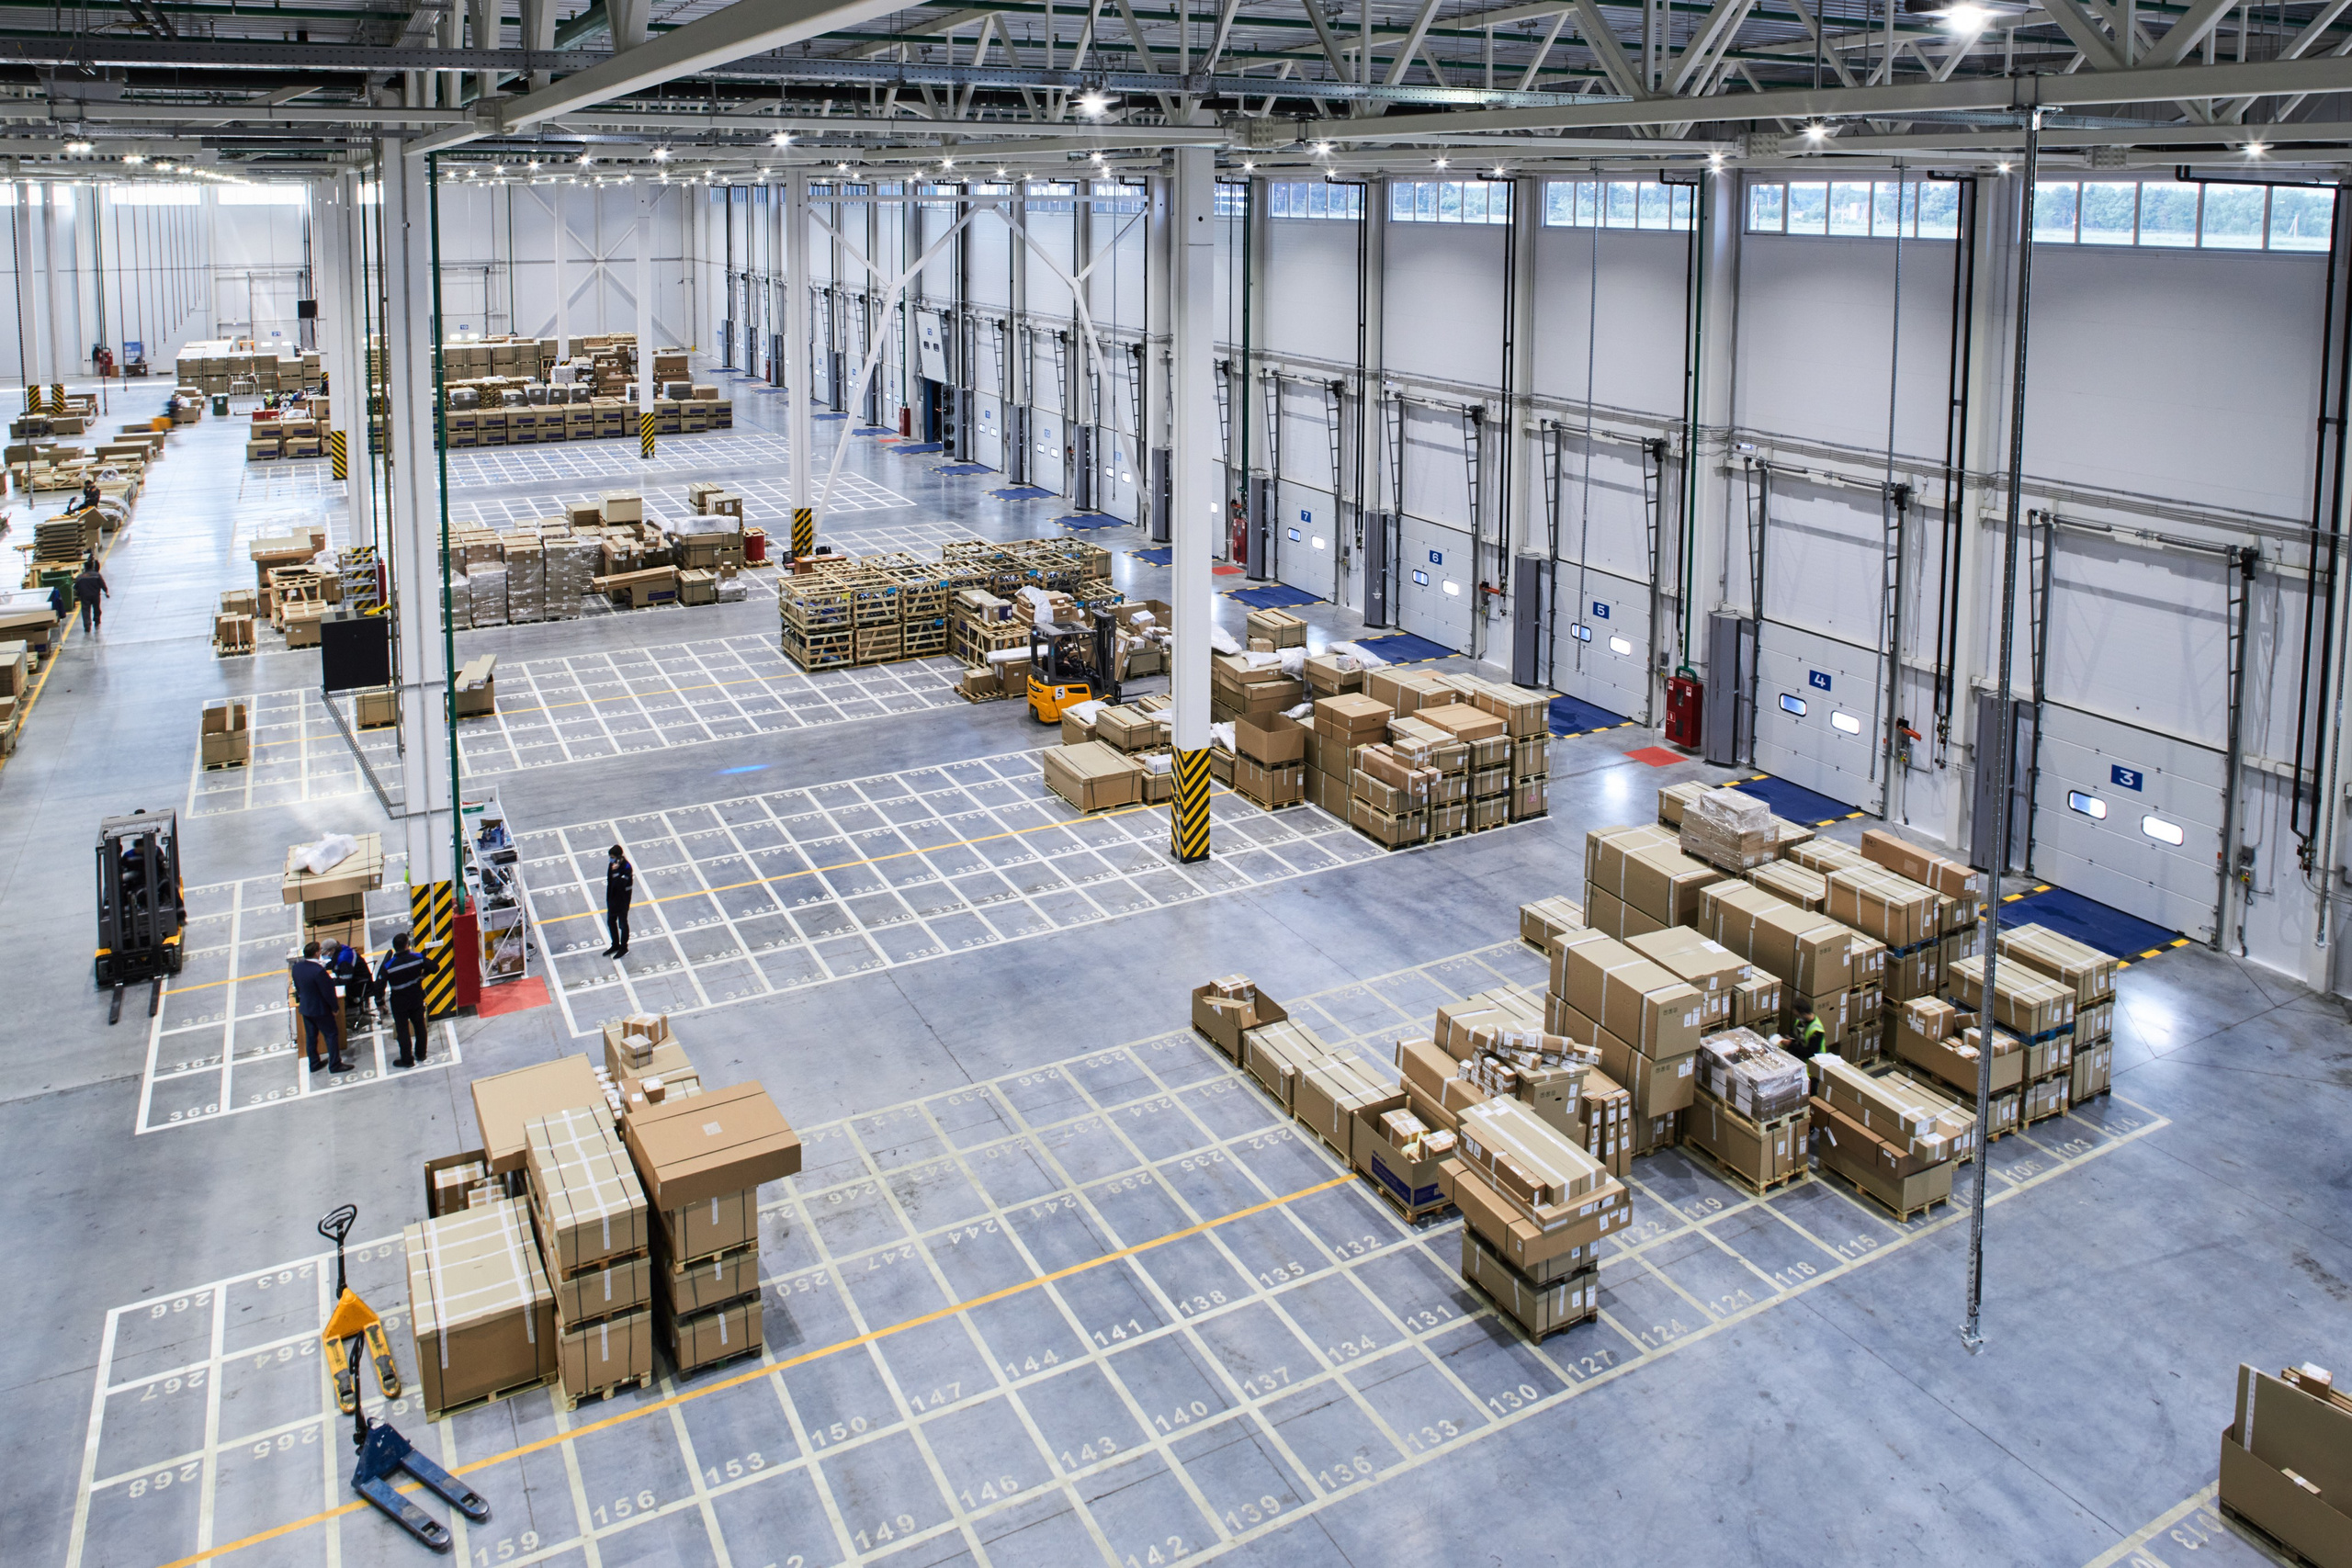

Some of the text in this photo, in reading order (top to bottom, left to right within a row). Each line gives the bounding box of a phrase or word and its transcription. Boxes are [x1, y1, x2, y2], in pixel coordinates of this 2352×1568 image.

[1432, 553, 1439, 563] 6
[1597, 605, 1605, 616] 5
[1057, 688, 1062, 697] 5
[1814, 673, 1826, 687] 4
[2119, 770, 2134, 786] 3
[662, 998, 701, 1013] 351
[181, 1012, 227, 1027] 368
[1151, 1033, 1190, 1051] 230
[175, 1055, 222, 1072] 367
[1086, 1051, 1125, 1068] 233
[330, 1069, 376, 1087] 360
[1018, 1068, 1059, 1087] 236
[1199, 1079, 1238, 1098] 231
[250, 1086, 299, 1104] 363
[1129, 1097, 1172, 1117] 234
[170, 1103, 220, 1122] 366
[1061, 1117, 1102, 1138] 237
[1250, 1130, 1292, 1150] 232
[1181, 1151, 1224, 1172] 235
[2056, 1138, 2092, 1159] 103
[1107, 1173, 1152, 1194] 238
[2005, 1160, 2043, 1181] 106
[828, 1183, 877, 1204] 246
[1029, 1196, 1076, 1218] 241
[1684, 1198, 1723, 1220] 119
[946, 1221, 998, 1244] 244
[1620, 1222, 1666, 1247] 122
[866, 1246, 914, 1270] 247
[1336, 1235, 1382, 1260] 132
[1838, 1235, 1878, 1258] 115
[258, 1263, 313, 1289] 263
[776, 1269, 829, 1298] 250
[1260, 1262, 1305, 1289] 135
[1775, 1260, 1816, 1286] 118
[152, 1291, 210, 1319] 266
[1179, 1290, 1227, 1316] 138
[1710, 1289, 1754, 1319] 121
[1408, 1304, 1453, 1331] 131
[1094, 1318, 1143, 1347] 141
[1641, 1318, 1688, 1348] 124
[254, 1338, 315, 1369] 264
[1006, 1348, 1058, 1378] 144
[1329, 1335, 1376, 1365] 134
[1567, 1349, 1614, 1380] 127
[141, 1369, 205, 1401] 267
[1245, 1366, 1291, 1396] 137
[910, 1382, 962, 1413] 147
[1489, 1384, 1538, 1416] 130
[1155, 1401, 1207, 1432] 140
[254, 1425, 319, 1460] 265
[812, 1416, 866, 1447] 150
[1408, 1419, 1458, 1451] 133
[1062, 1436, 1116, 1467] 143
[129, 1461, 199, 1498] 268
[707, 1452, 765, 1484] 153
[1318, 1456, 1373, 1491] 136
[961, 1475, 1020, 1506] 146
[594, 1489, 656, 1525] 156
[1226, 1495, 1281, 1530] 139
[855, 1514, 915, 1549] 149
[475, 1529, 539, 1565] 159
